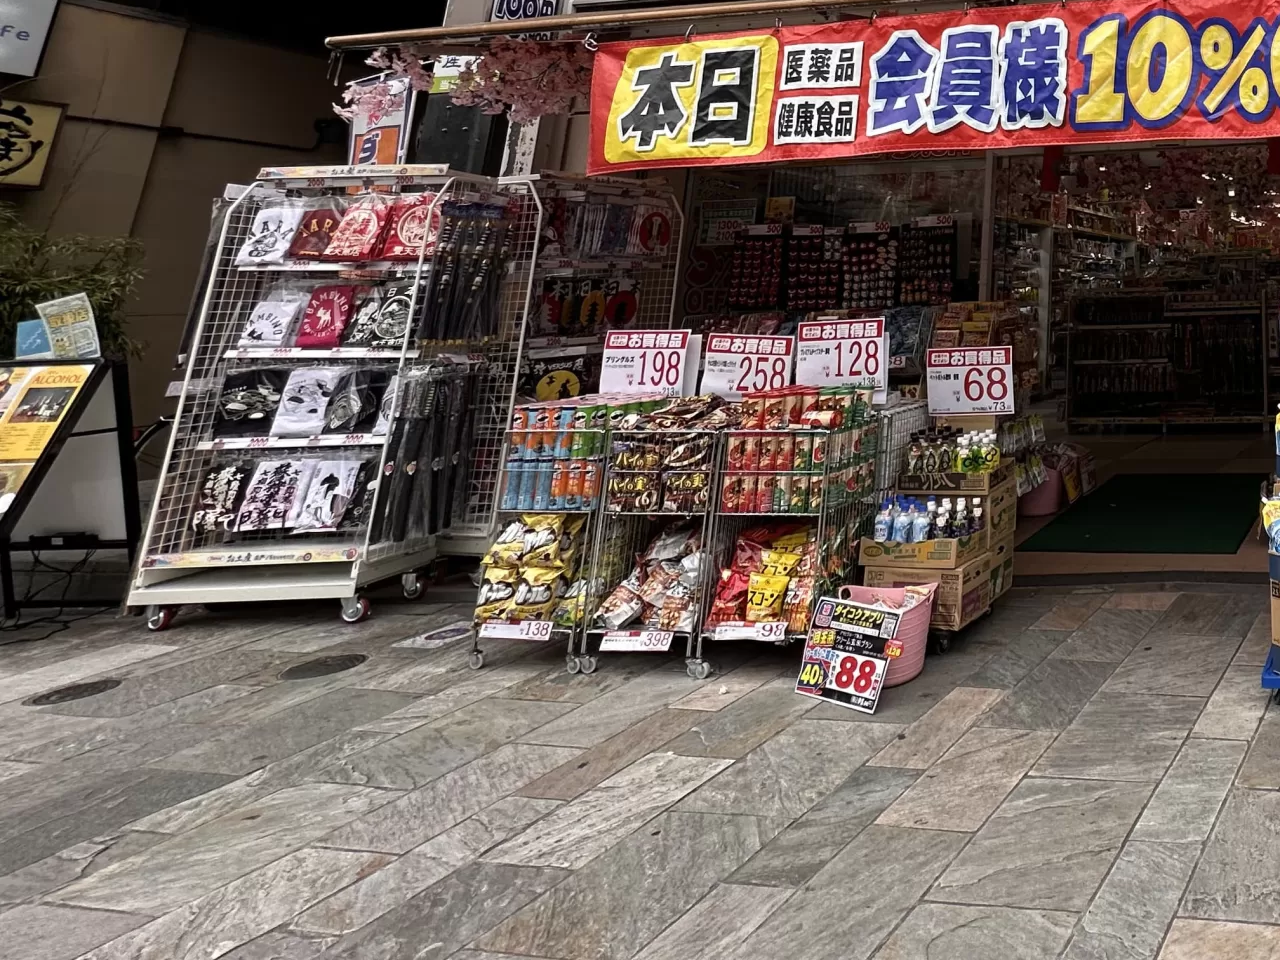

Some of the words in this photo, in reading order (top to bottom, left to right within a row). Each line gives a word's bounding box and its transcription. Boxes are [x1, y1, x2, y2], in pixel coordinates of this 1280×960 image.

[786, 48, 856, 86] 医薬品
[866, 17, 1067, 136] 会員様
[617, 45, 762, 152] 本日
[777, 100, 855, 139] 健康食品
[628, 333, 683, 348] お買得品
[822, 322, 878, 340] お買得品
[730, 338, 787, 354] お買得品
[834, 340, 879, 377] 128
[951, 351, 1006, 365] お買得品
[638, 351, 680, 386] 198
[736, 356, 786, 392] 258
[32, 373, 83, 385] ALCOHOL
[964, 367, 1008, 401] 68
[748, 589, 780, 608] スコーン
[835, 606, 884, 624] ダイコクアプリ
[525, 623, 549, 637] 138
[643, 632, 671, 646] 398
[761, 624, 783, 637] 98
[835, 656, 876, 693] 88
